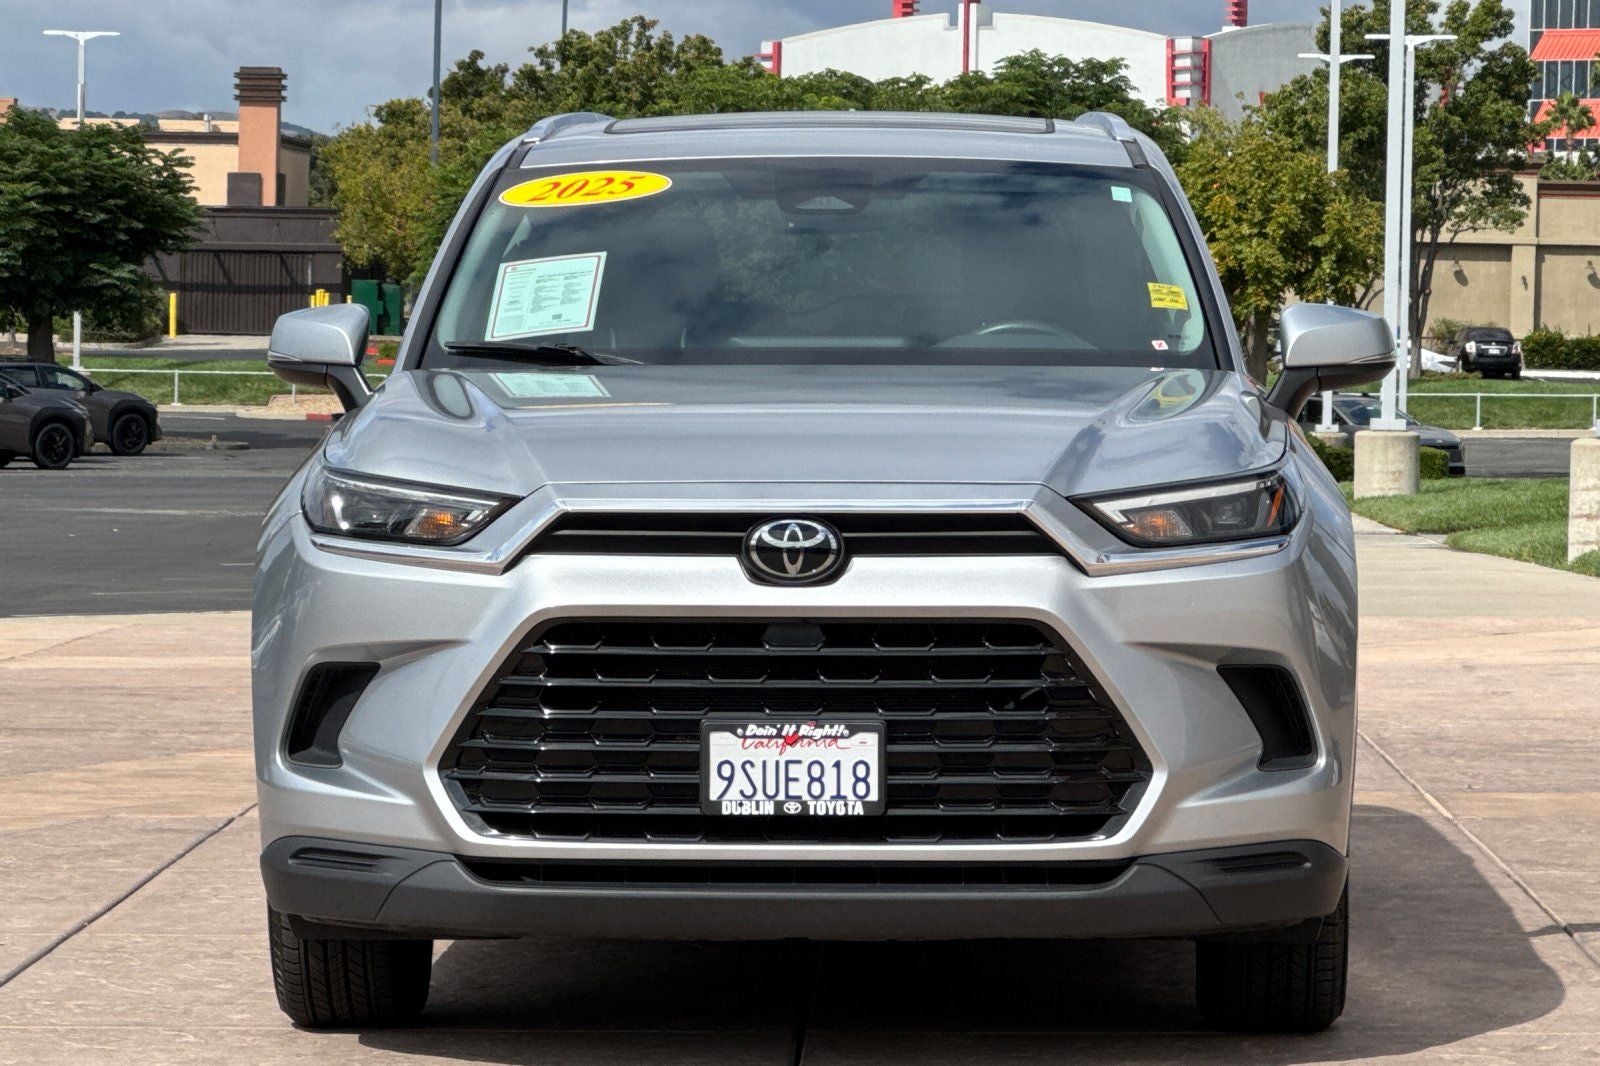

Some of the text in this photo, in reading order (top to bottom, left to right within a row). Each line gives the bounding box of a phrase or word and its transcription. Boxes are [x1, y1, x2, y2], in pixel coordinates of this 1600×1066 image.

[527, 175, 646, 202] 2025
[745, 724, 845, 740] Doin' It Right!
[741, 736, 851, 756] Califrnia
[717, 759, 871, 800] 9SUE818
[721, 801, 864, 815] DUBLIN TOYOTA
